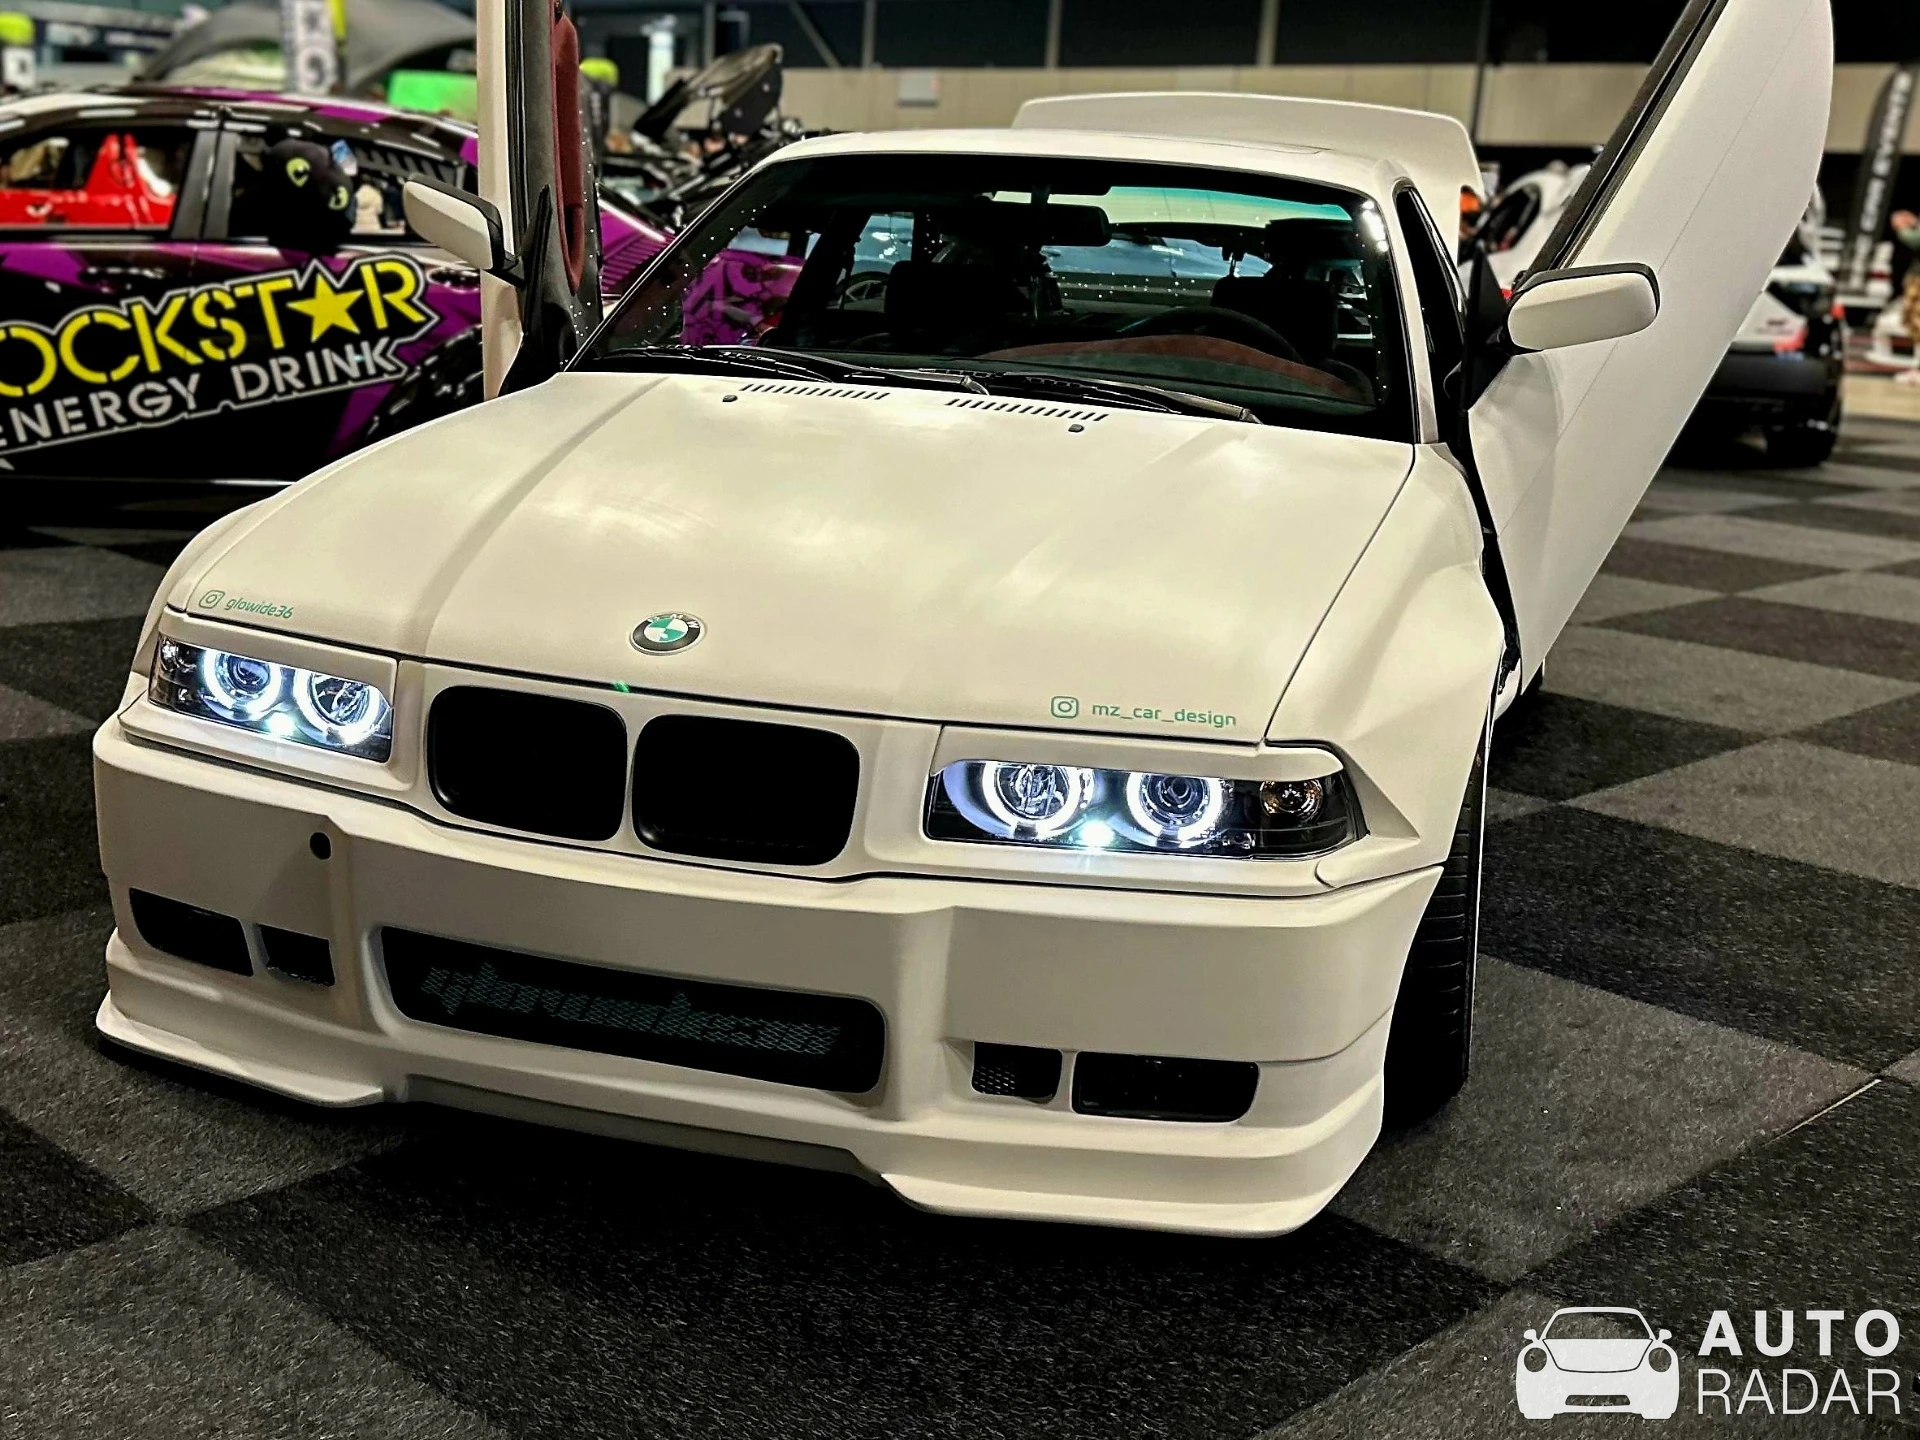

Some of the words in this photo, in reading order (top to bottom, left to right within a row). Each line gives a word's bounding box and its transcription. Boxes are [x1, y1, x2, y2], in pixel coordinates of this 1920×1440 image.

[0, 373, 200, 447] NERGY
[231, 337, 400, 400] DRINK
[225, 598, 293, 618] glowide36
[1092, 704, 1236, 728] mz_car_design
